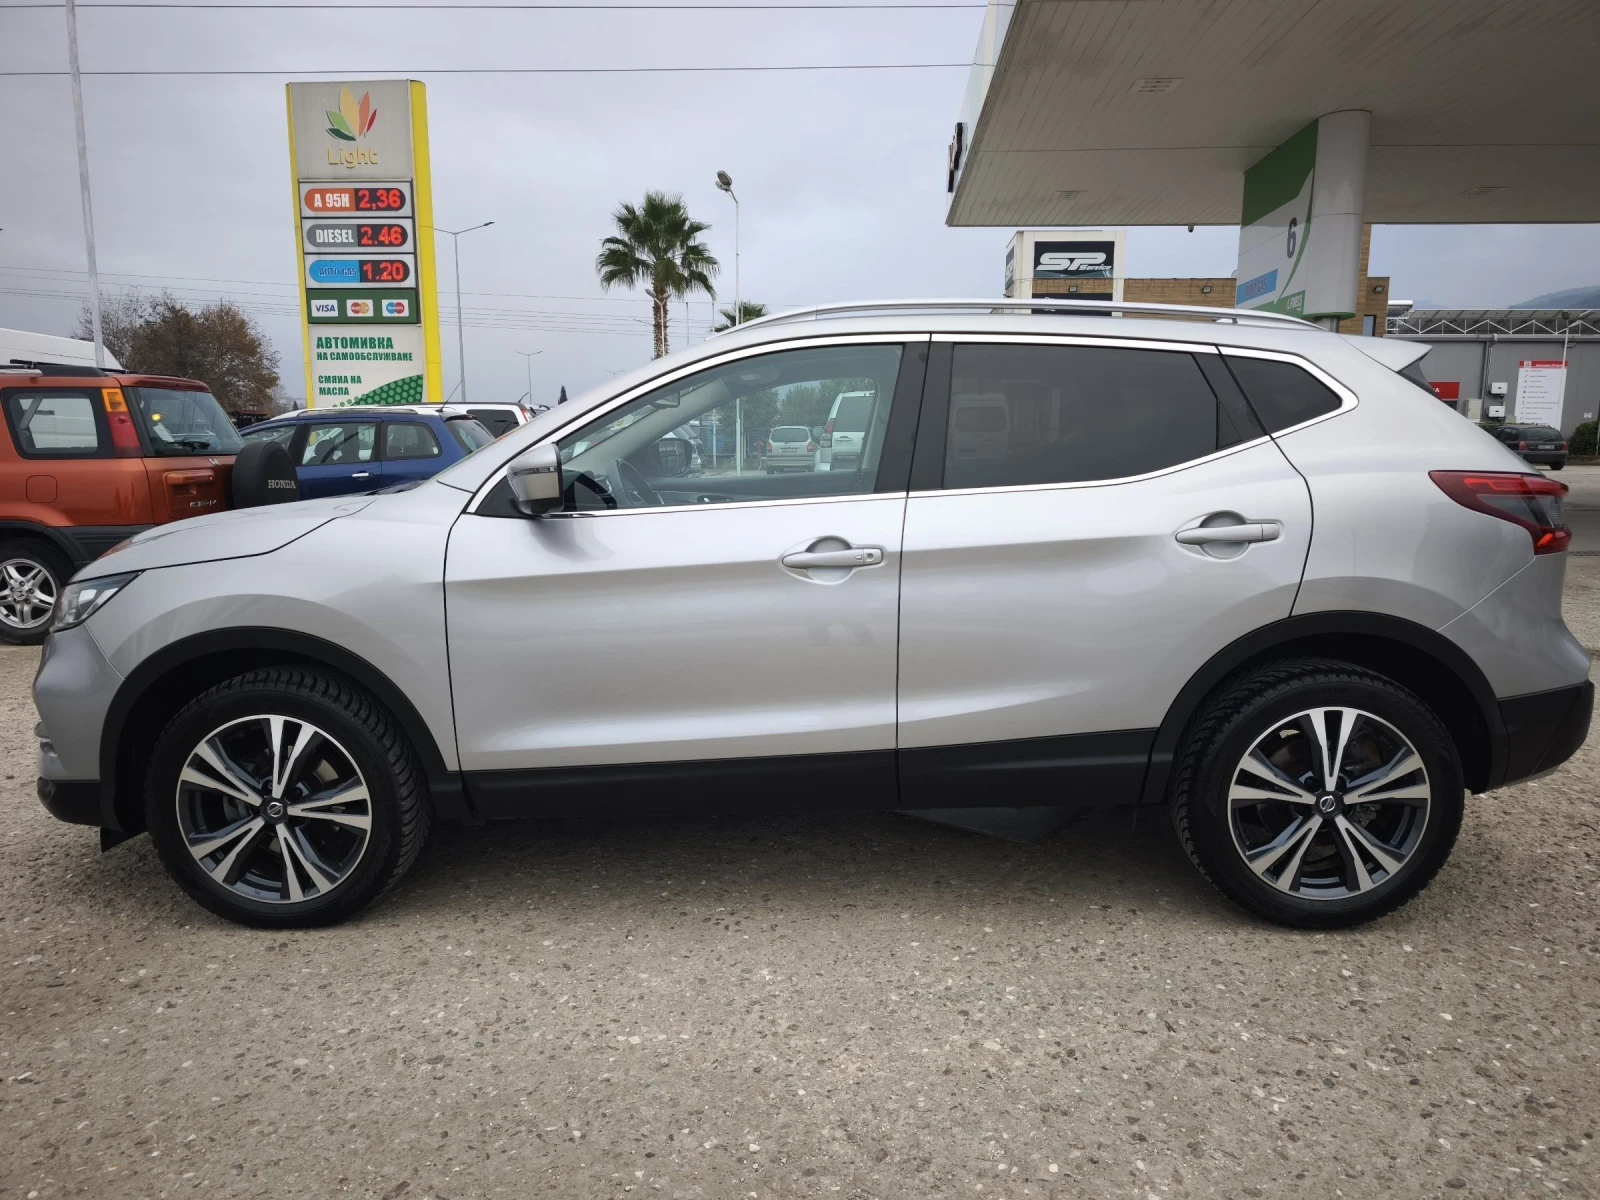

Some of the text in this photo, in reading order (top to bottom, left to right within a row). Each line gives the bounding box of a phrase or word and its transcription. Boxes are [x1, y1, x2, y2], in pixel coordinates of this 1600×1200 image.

[326, 145, 378, 170] Light
[315, 226, 403, 245] DIESEL 2.46
[1287, 217, 1297, 259] 6
[1035, 252, 1112, 271] SP Service
[319, 262, 404, 280] AUTO GAS 1.20
[315, 304, 336, 313] VISA
[316, 337, 394, 350] АВТОМИВКА
[316, 352, 413, 361] НА САМООБСЛУЖВАНЕ
[318, 375, 362, 384] СМЯНА НА
[319, 387, 349, 396] МАСЛА
[267, 479, 296, 489] HONDA
